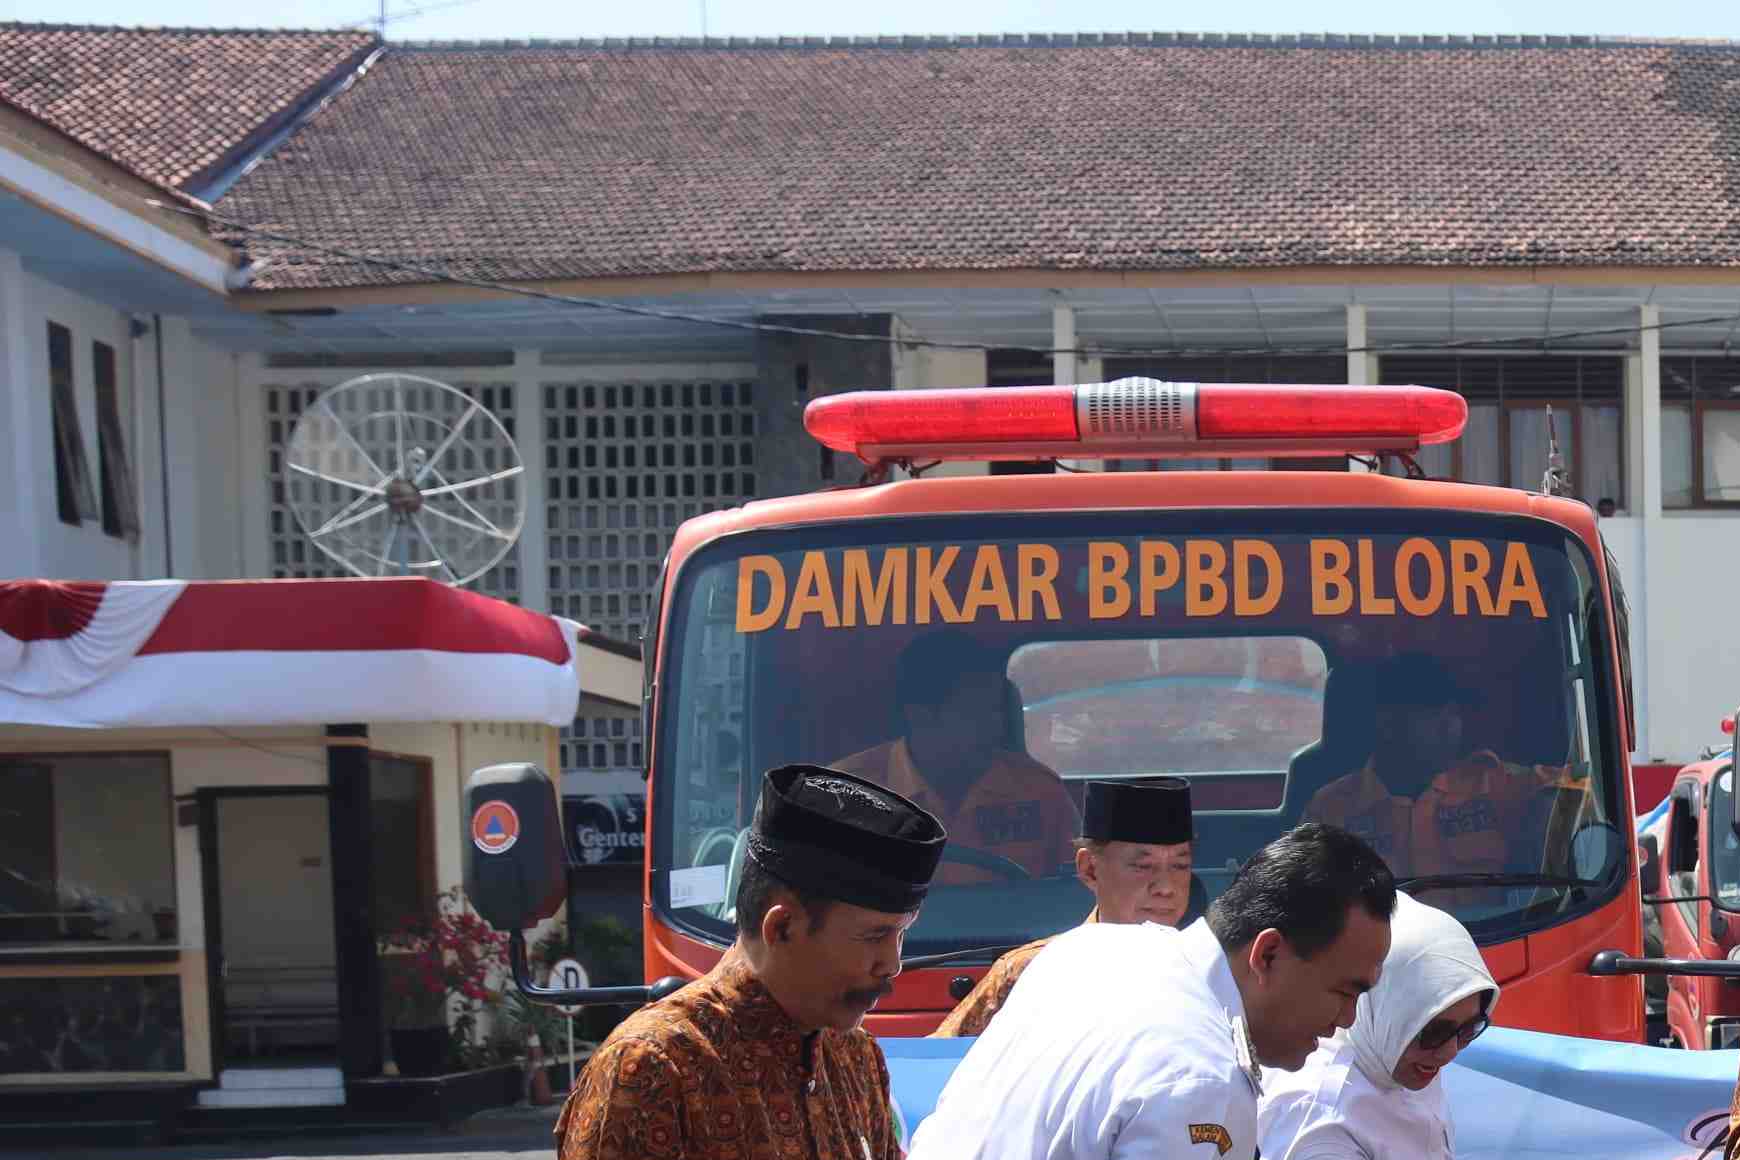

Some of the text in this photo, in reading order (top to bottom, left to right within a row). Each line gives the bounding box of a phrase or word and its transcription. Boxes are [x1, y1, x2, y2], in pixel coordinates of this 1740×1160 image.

[736, 537, 1548, 633] DAMKAR BPBD BLORA
